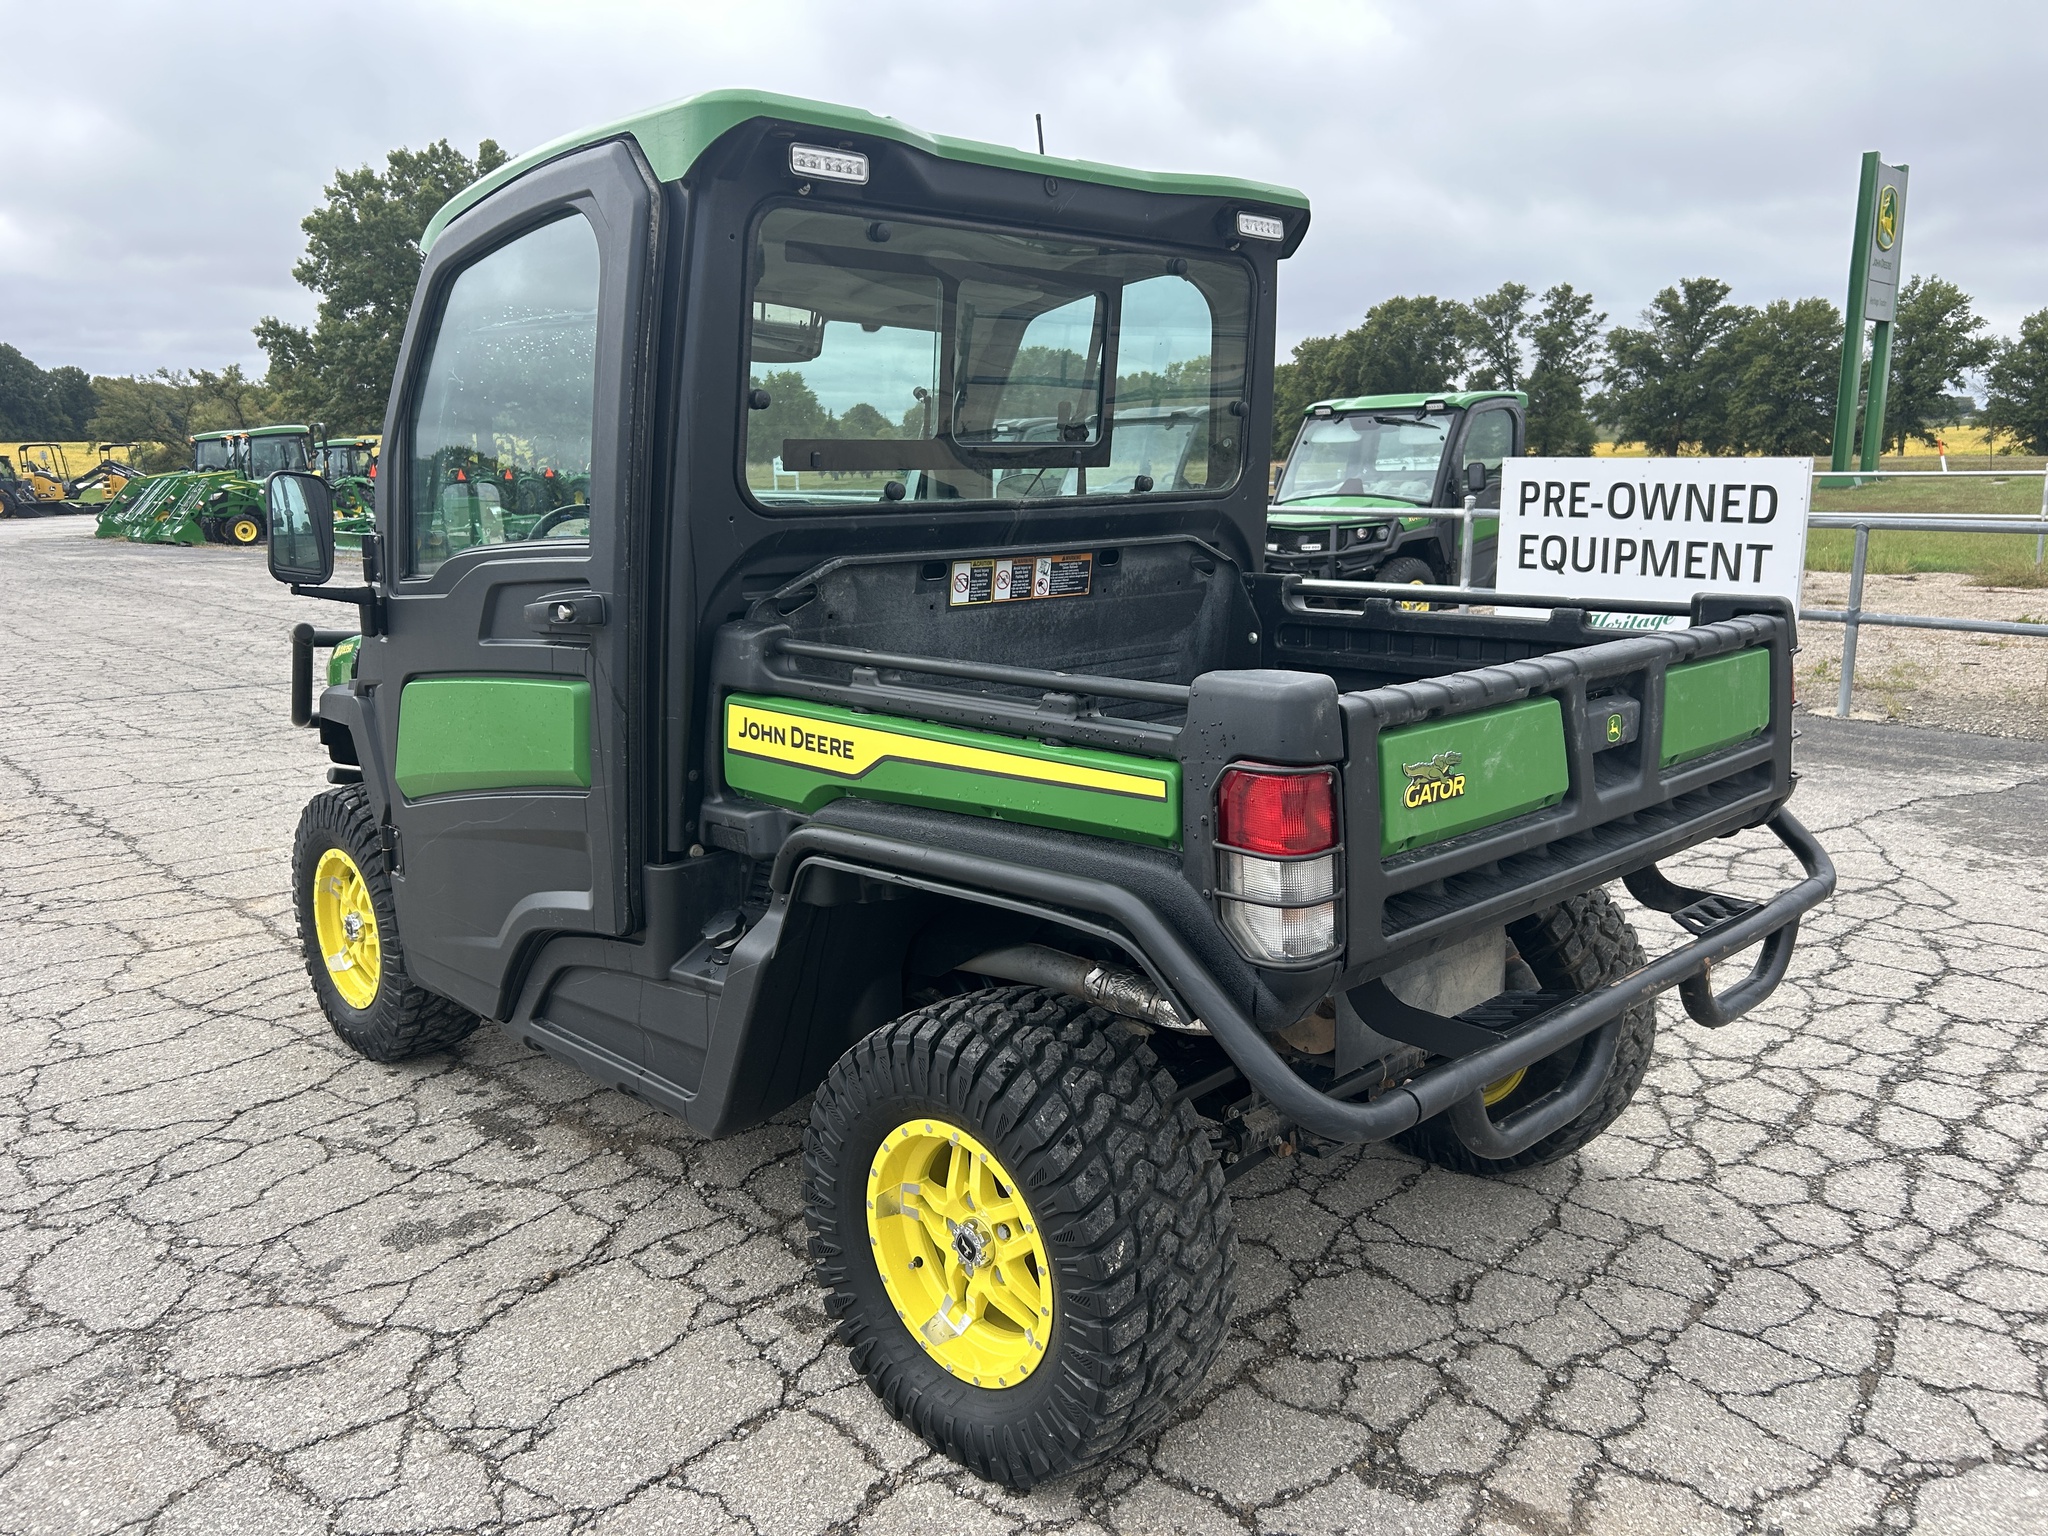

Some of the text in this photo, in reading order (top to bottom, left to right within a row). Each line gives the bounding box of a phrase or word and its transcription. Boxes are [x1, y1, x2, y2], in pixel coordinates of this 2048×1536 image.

[1518, 480, 1779, 524] PRE-OWNED
[1518, 534, 1774, 584] EQUIPMENT
[738, 717, 855, 760] JOHN DEERE
[1405, 775, 1466, 808] GATOR
